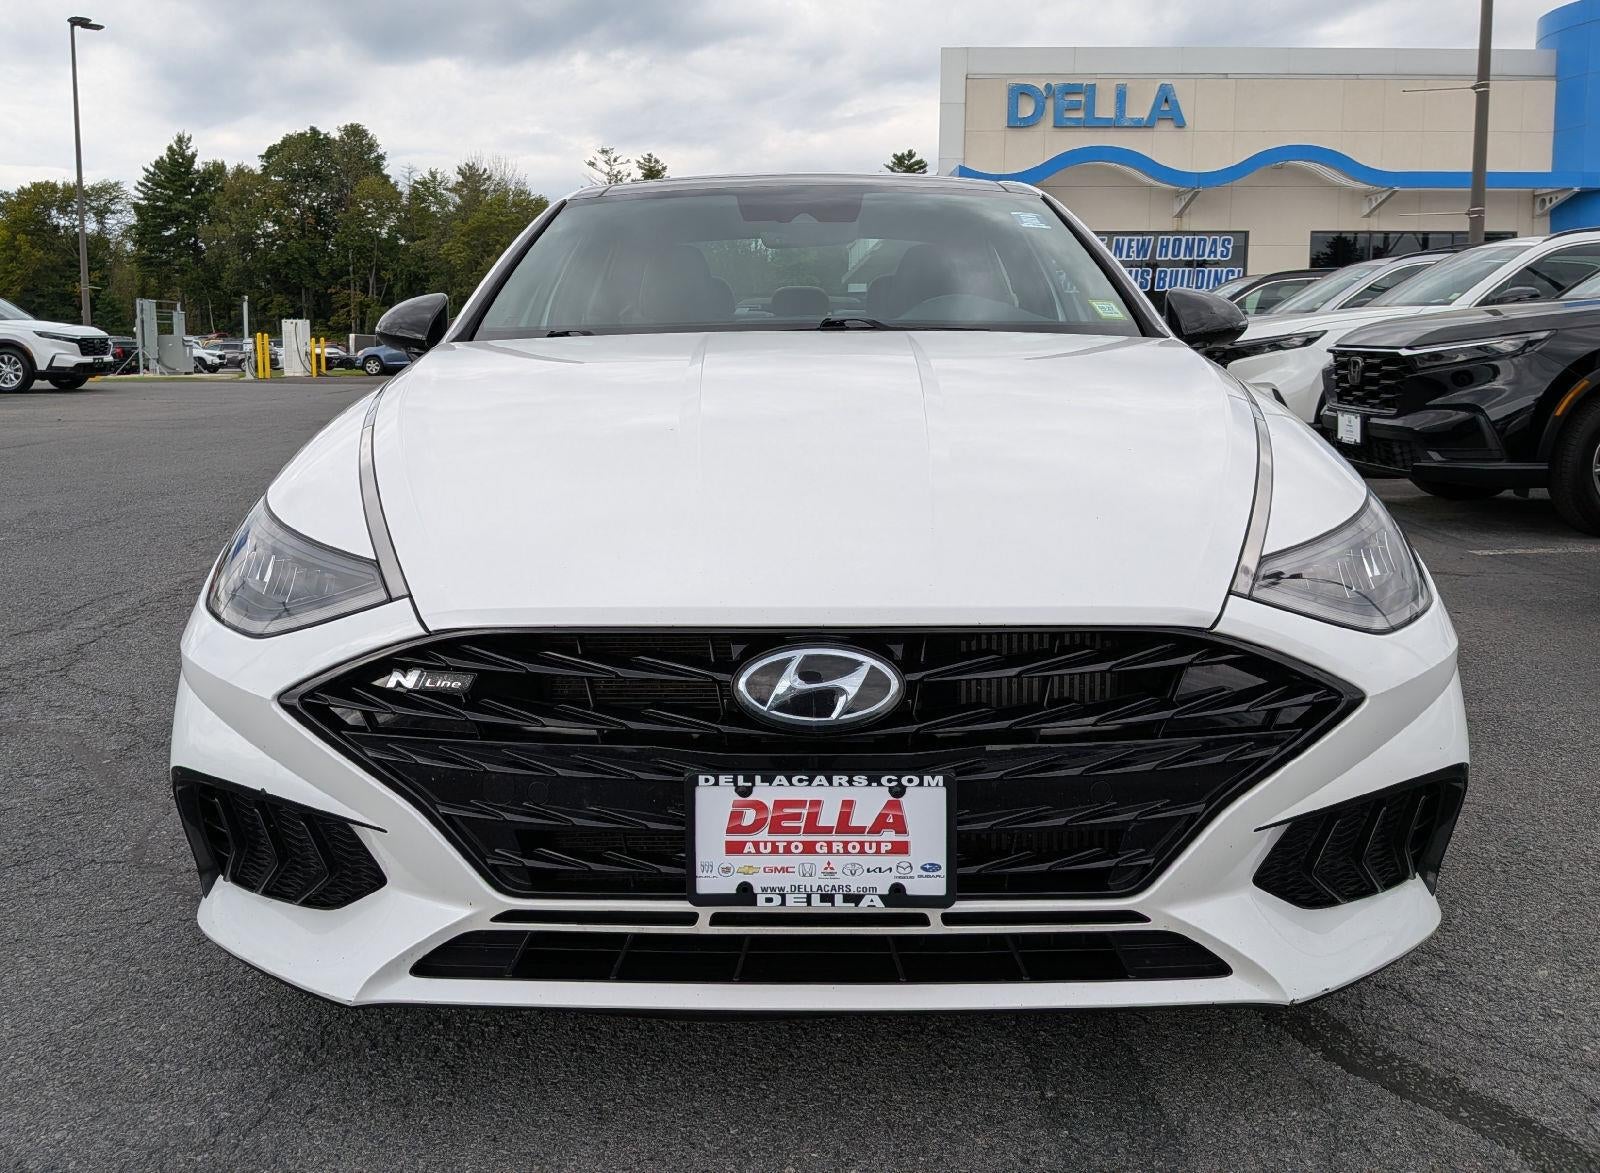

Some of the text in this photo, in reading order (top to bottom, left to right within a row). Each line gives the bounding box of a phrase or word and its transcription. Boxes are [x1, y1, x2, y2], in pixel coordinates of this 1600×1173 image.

[1007, 82, 1187, 128] D'ELLA
[1112, 236, 1154, 260] NEW
[1156, 235, 1233, 260] HONDAS
[1125, 267, 1152, 291] IS
[698, 775, 944, 787] DELLACARS.COM
[725, 799, 910, 836] DELLA
[742, 841, 893, 854] AUTO GROUP
[762, 866, 796, 874] GMC
[760, 884, 878, 893] www.DELLACARS.com
[756, 893, 885, 908] DELLA
